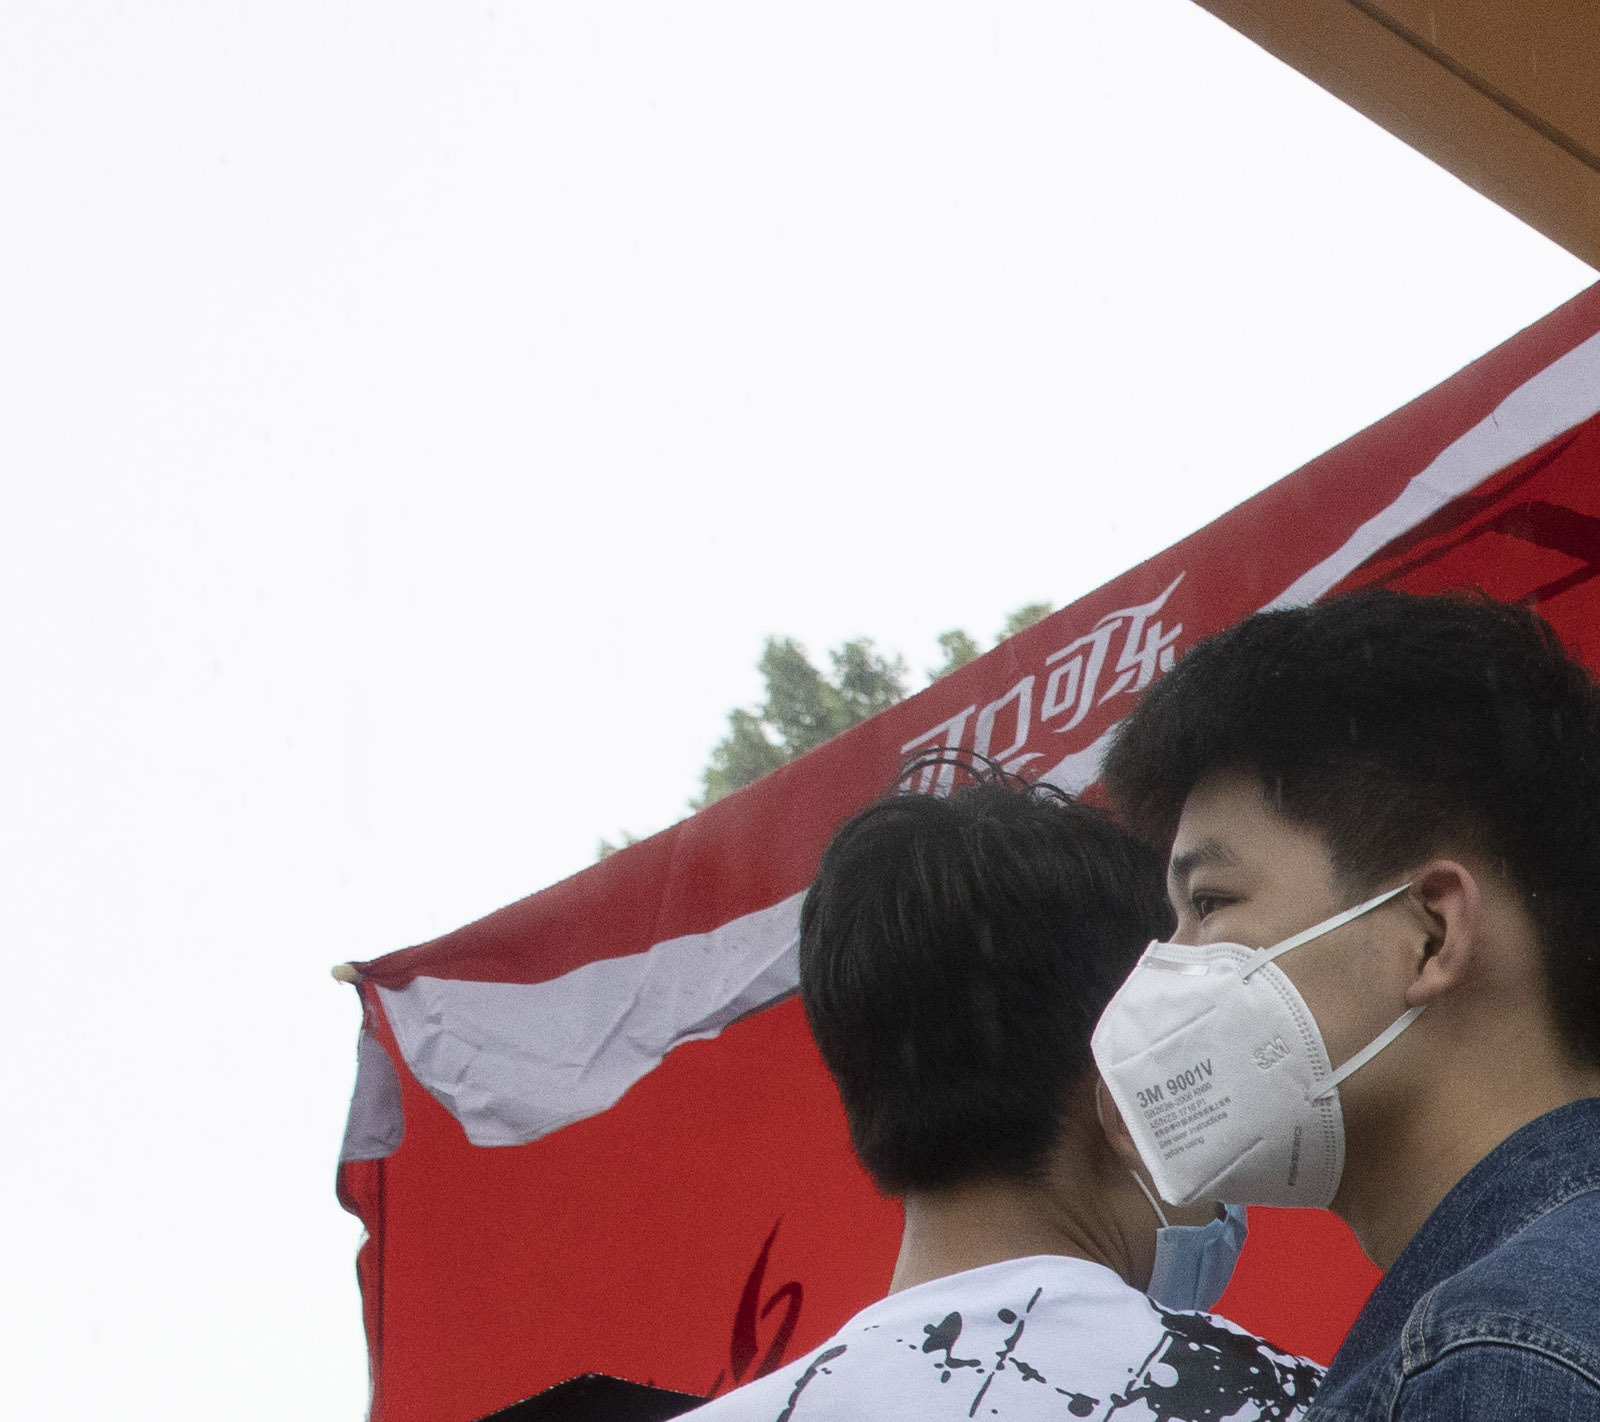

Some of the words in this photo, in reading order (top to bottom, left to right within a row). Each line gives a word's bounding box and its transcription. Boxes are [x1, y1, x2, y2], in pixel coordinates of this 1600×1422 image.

[1253, 1035, 1291, 1070] 3M
[1136, 1084, 1165, 1108] 3M
[1166, 1058, 1214, 1096] 9001V
